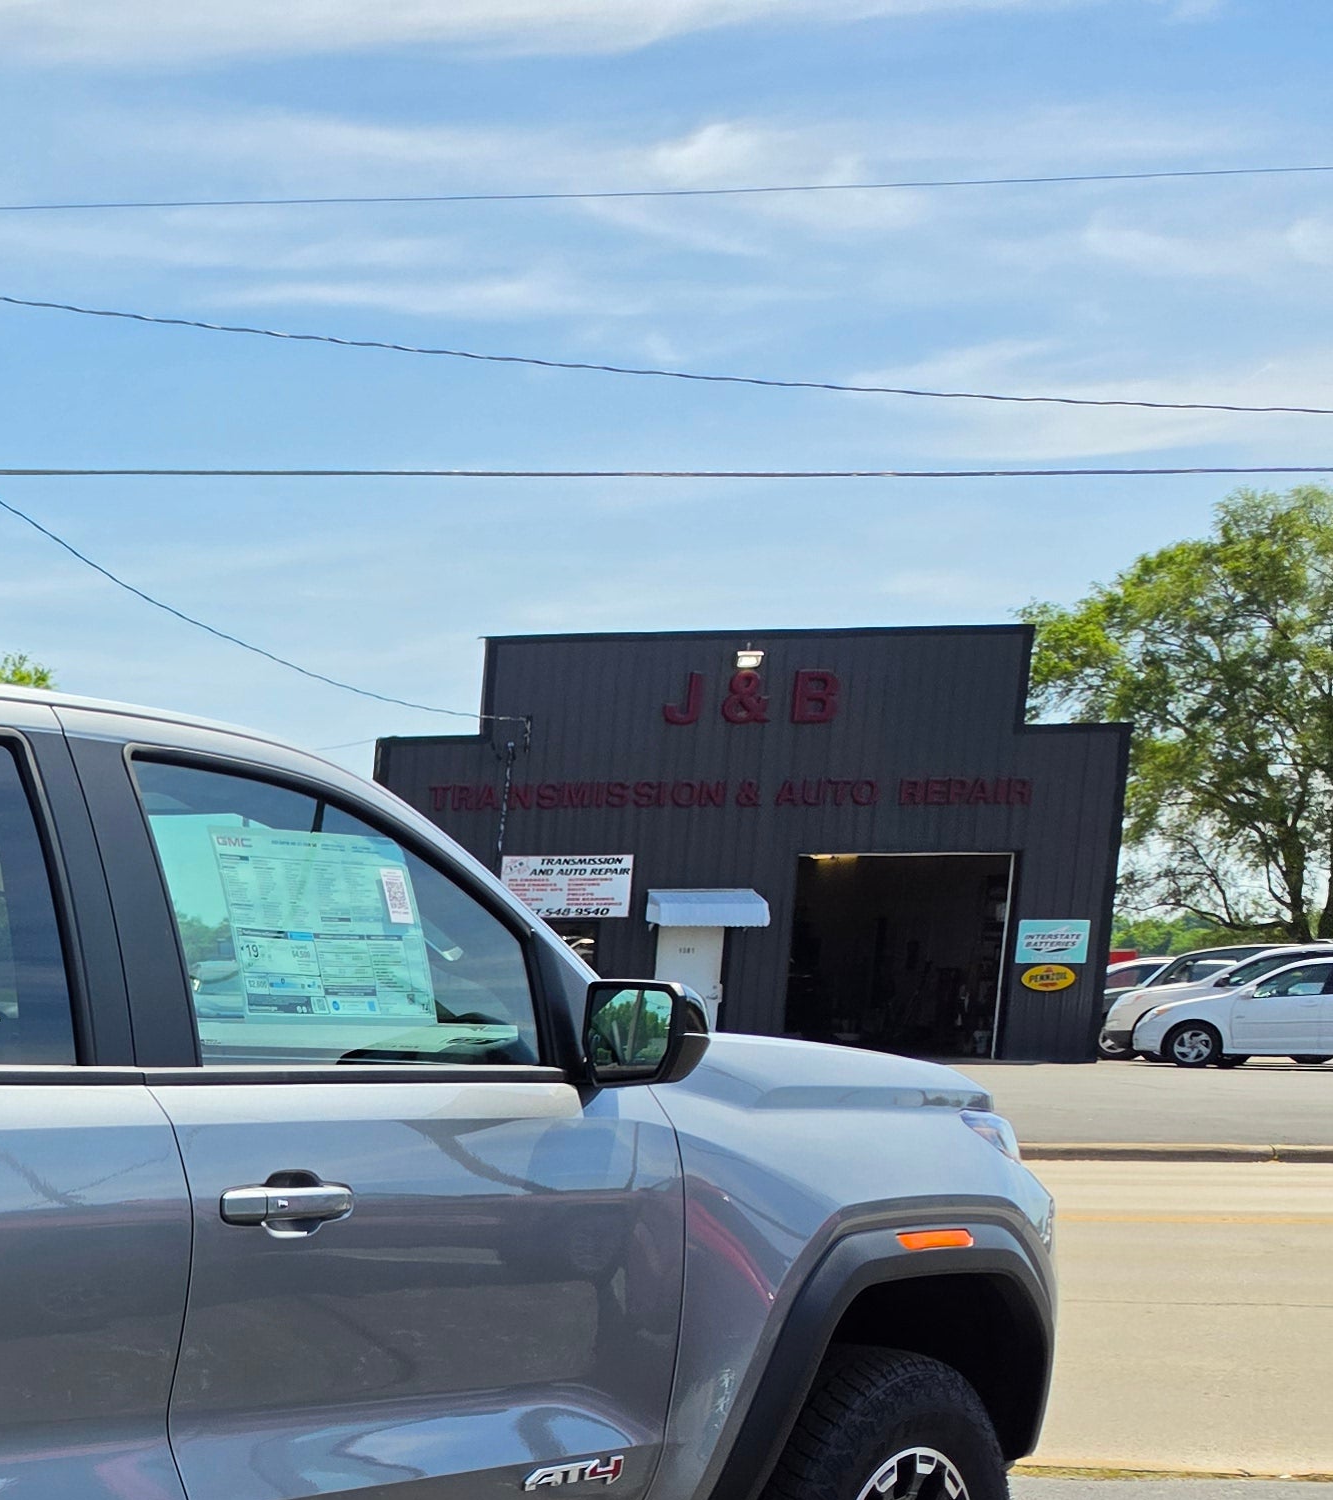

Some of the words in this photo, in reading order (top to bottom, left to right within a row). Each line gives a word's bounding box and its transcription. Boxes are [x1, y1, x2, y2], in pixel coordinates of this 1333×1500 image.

[662, 671, 704, 726] J
[721, 669, 771, 725] &
[791, 669, 841, 725] B
[429, 776, 727, 812] TRANSMISSION
[736, 777, 762, 808] &
[774, 776, 880, 809] AUTO
[897, 775, 1035, 808] REPAIR
[216, 836, 253, 848] GMC
[540, 857, 624, 866] TRANSMISSION
[529, 868, 555, 876] AND
[556, 868, 588, 876] AUTO
[589, 867, 631, 876] REPAIR
[532, 907, 610, 916] 7-548-9540
[1024, 940, 1077, 948] BATTERIES
[1028, 972, 1068, 984] PENNZOIL
[524, 1455, 625, 1492] AT4
